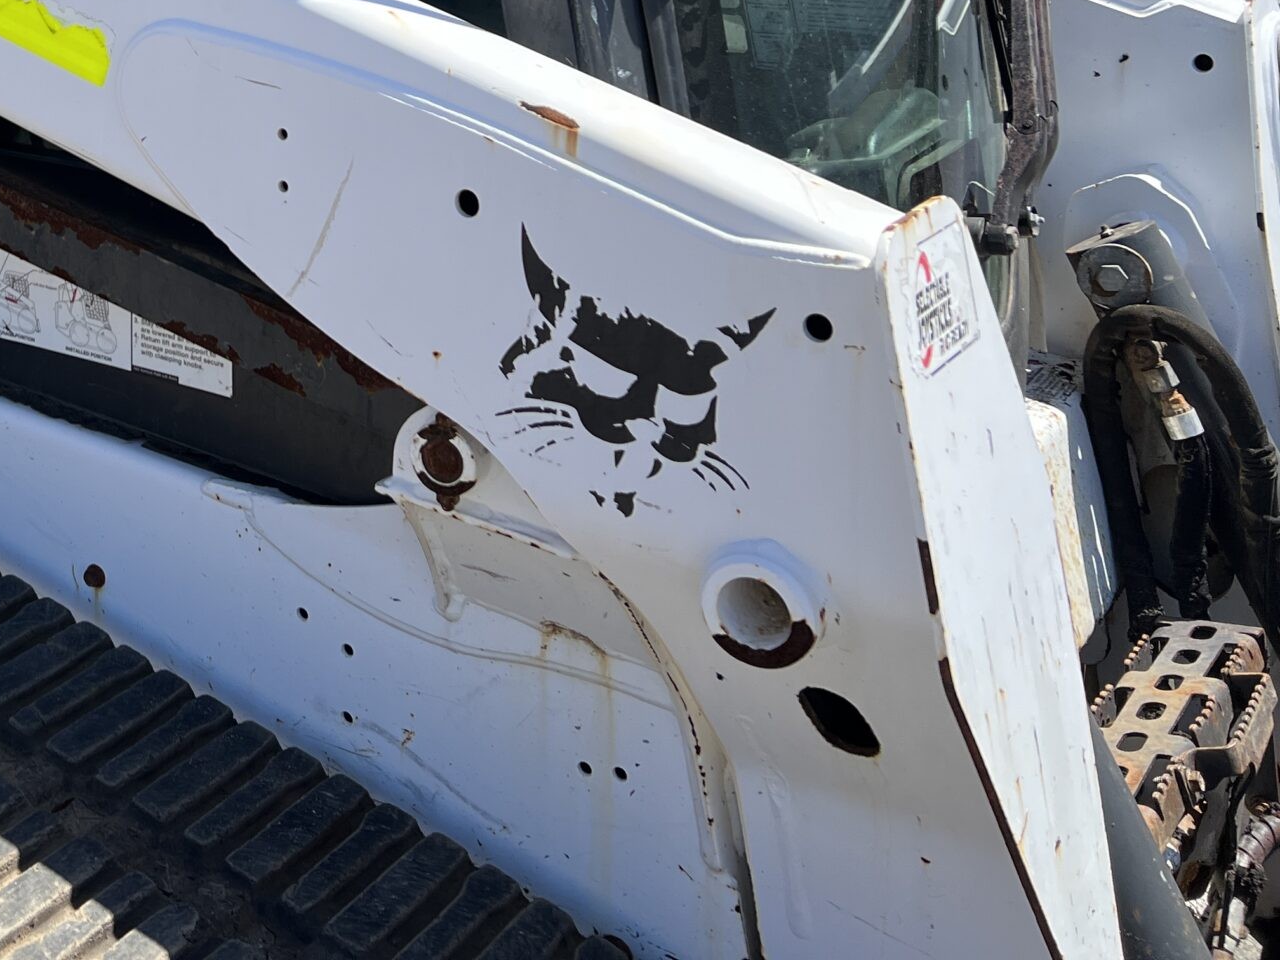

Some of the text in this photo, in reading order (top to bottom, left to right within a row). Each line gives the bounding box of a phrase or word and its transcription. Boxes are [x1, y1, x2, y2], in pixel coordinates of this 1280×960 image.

[141, 326, 150, 334] are
[65, 346, 112, 362] INSTALLED POSITION
[141, 334, 160, 345] Return
[172, 342, 182, 350] arm
[184, 344, 208, 358] support
[141, 349, 153, 358] with
[141, 342, 224, 369] storage position and secure
